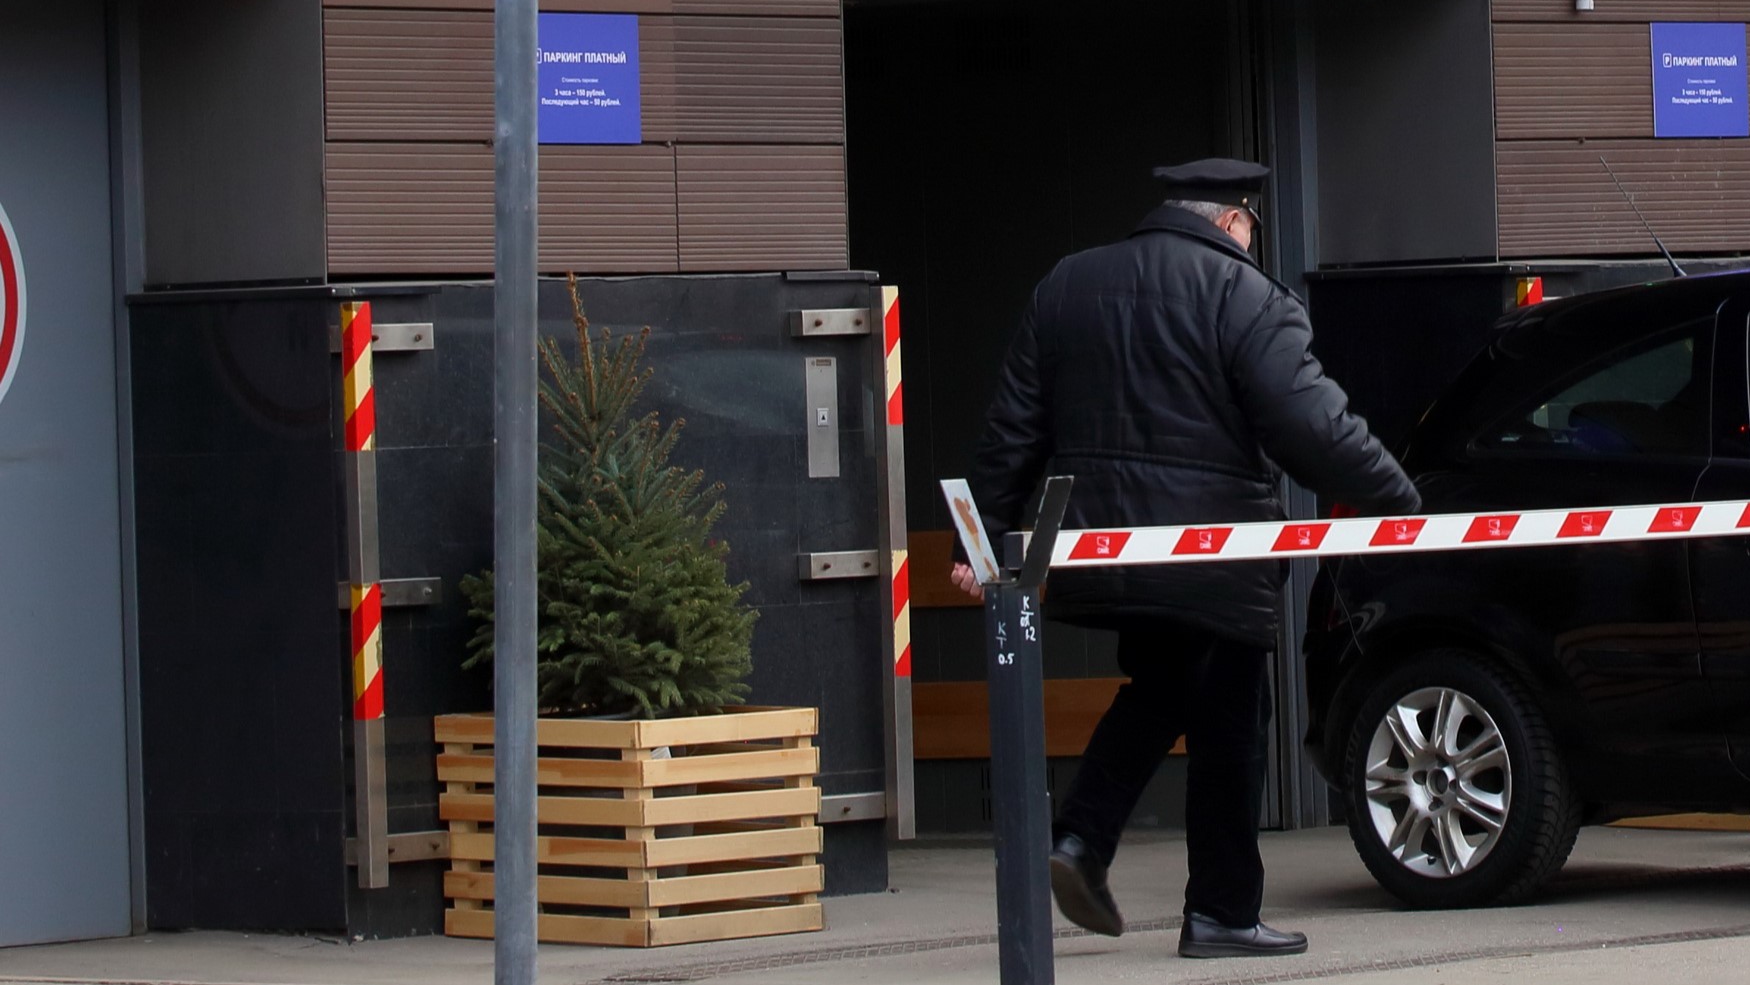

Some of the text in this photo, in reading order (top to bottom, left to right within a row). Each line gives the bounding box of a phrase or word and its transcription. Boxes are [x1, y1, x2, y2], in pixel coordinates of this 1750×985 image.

[544, 51, 626, 63] ПАРКИНГ ПЛАТНЫЙ
[1673, 55, 1737, 66] ПАРКИНГ ПЛАТНЫЙ
[998, 653, 1015, 665] 0.5
